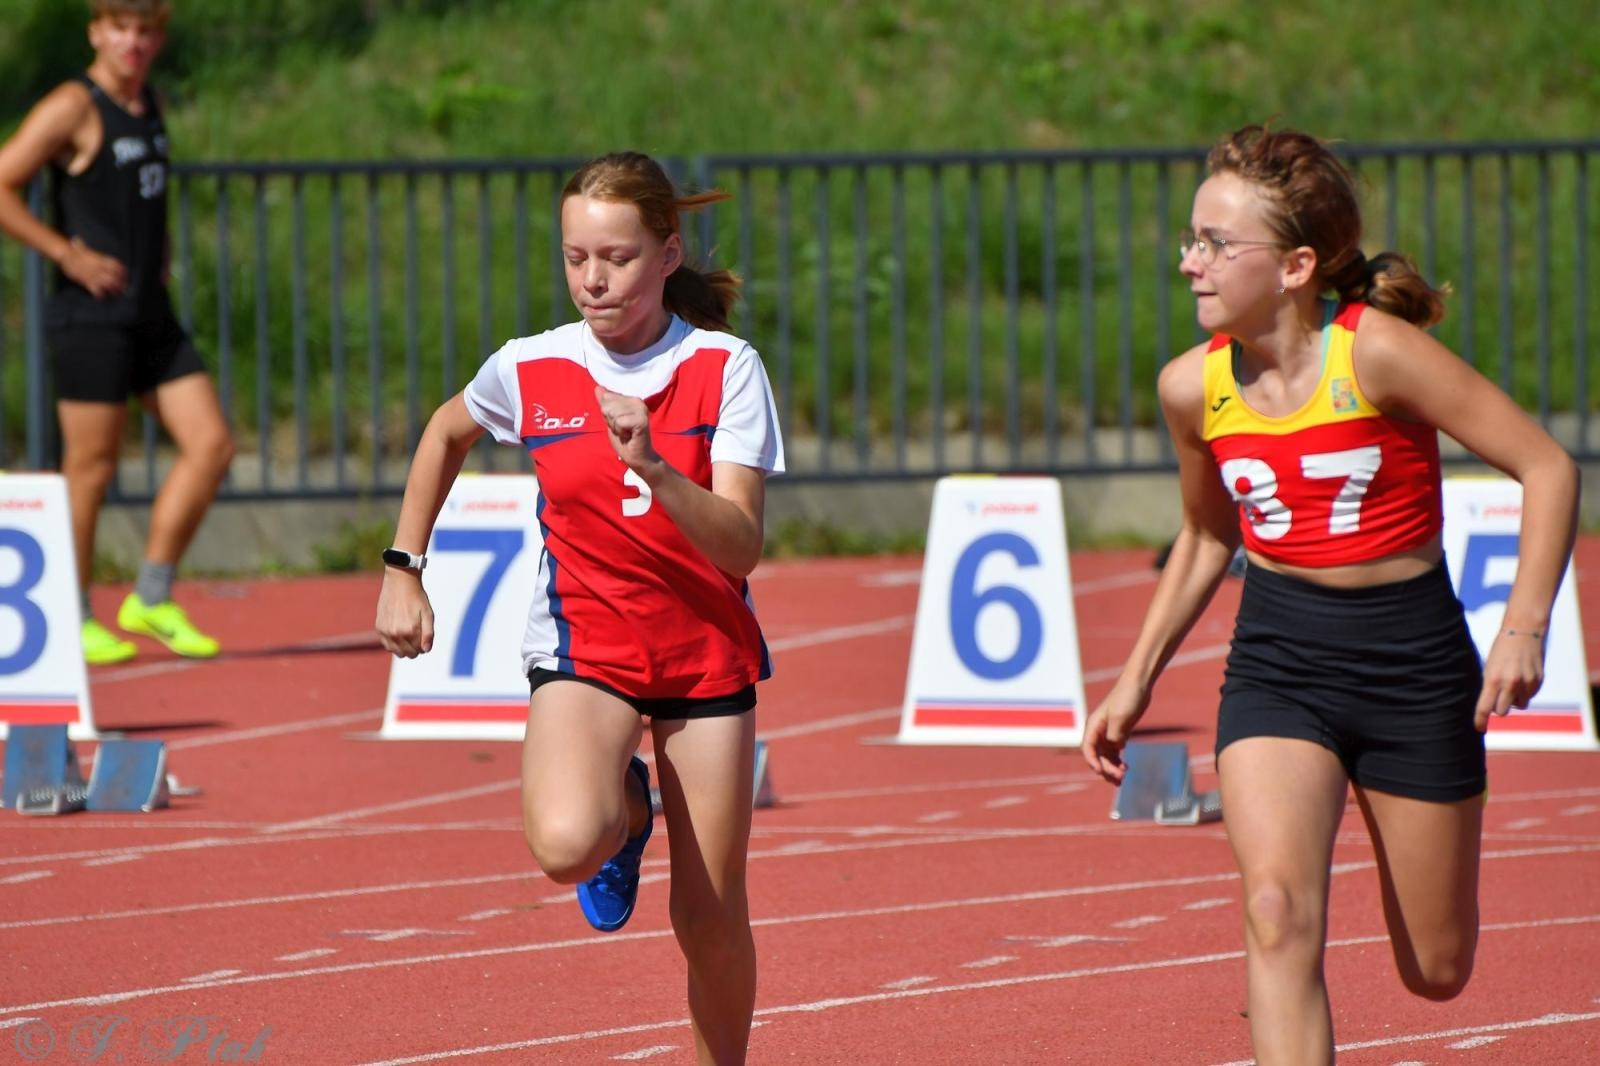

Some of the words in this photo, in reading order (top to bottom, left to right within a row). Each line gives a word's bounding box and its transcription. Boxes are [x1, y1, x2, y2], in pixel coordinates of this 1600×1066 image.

[1220, 444, 1382, 540] 87
[432, 527, 525, 677] 7
[948, 530, 1044, 681] 6
